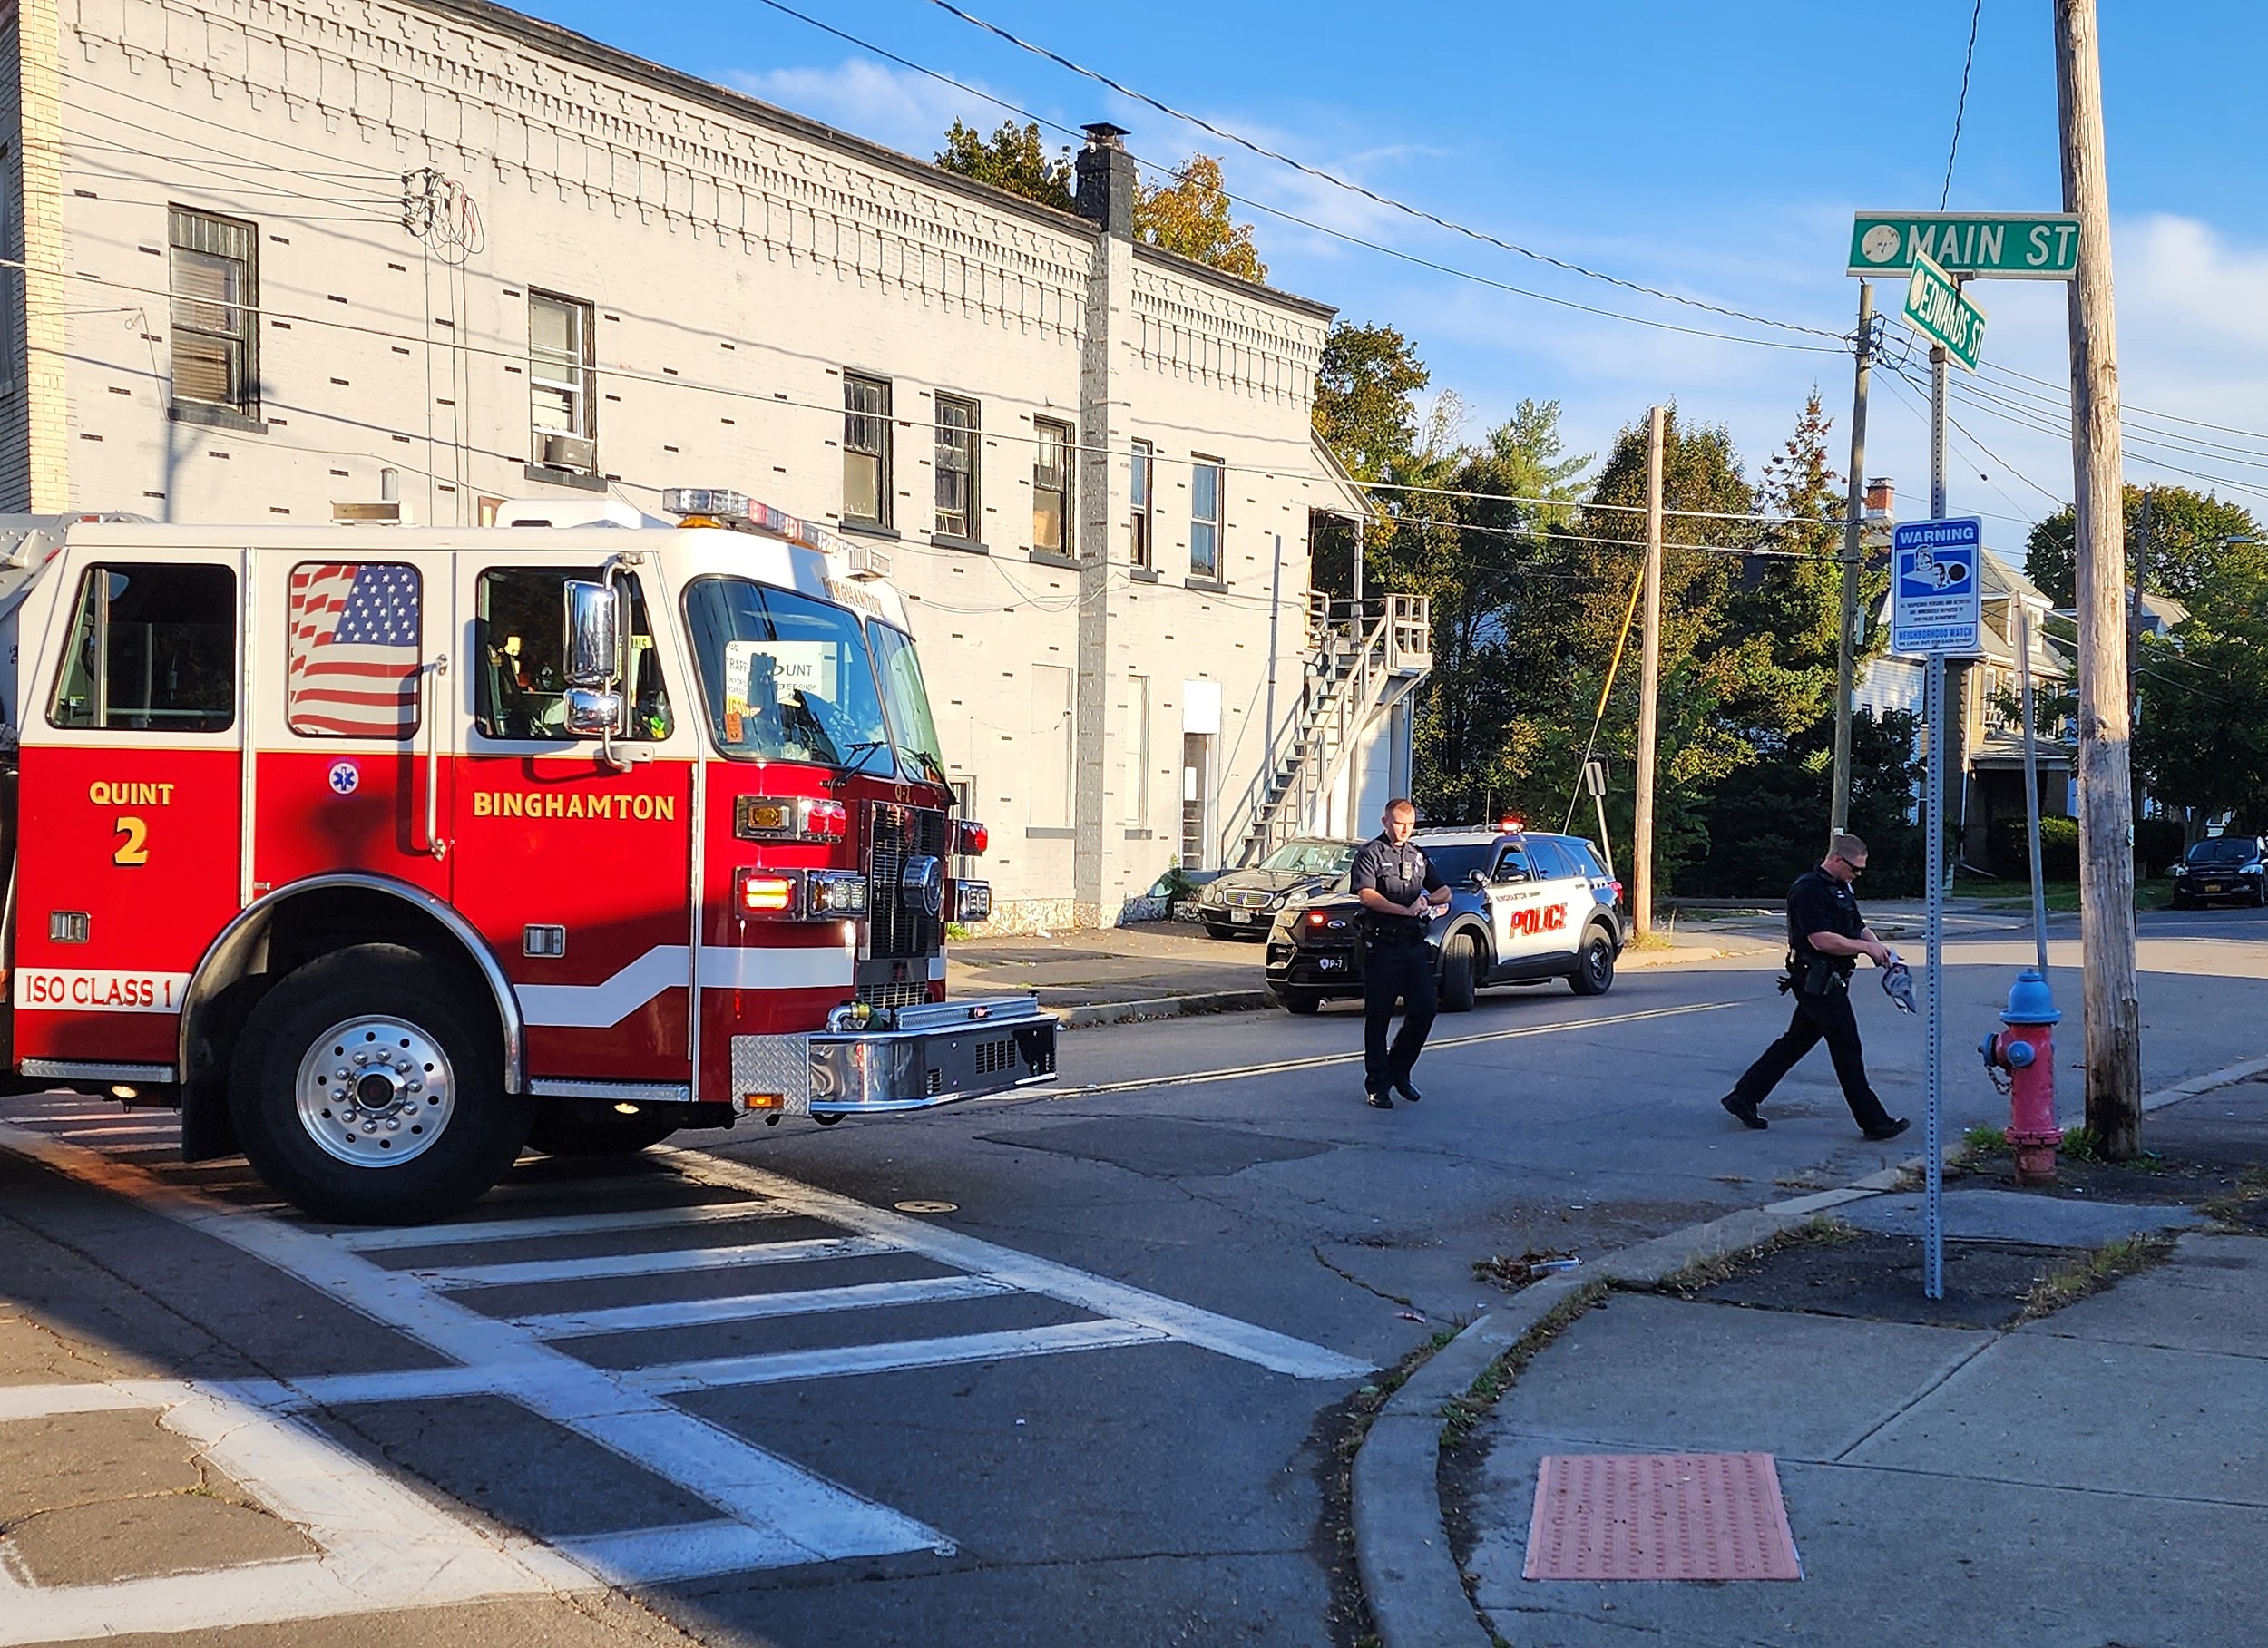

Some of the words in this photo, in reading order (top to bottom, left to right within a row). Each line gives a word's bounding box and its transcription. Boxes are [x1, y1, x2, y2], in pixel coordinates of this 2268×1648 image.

[1906, 225, 2004, 265] MAIN
[2026, 225, 2076, 266] ST
[1968, 319, 1985, 362] ST
[1900, 527, 1974, 544] WARNING
[1949, 627, 1972, 637] WATCH
[89, 781, 175, 805] QUINT
[473, 792, 675, 821] BINGHAMTON
[113, 816, 148, 866] 2
[1509, 902, 1568, 939] POLICE
[25, 975, 64, 1003] ISO
[73, 977, 154, 1007] CLASS
[164, 980, 171, 1008] 1
